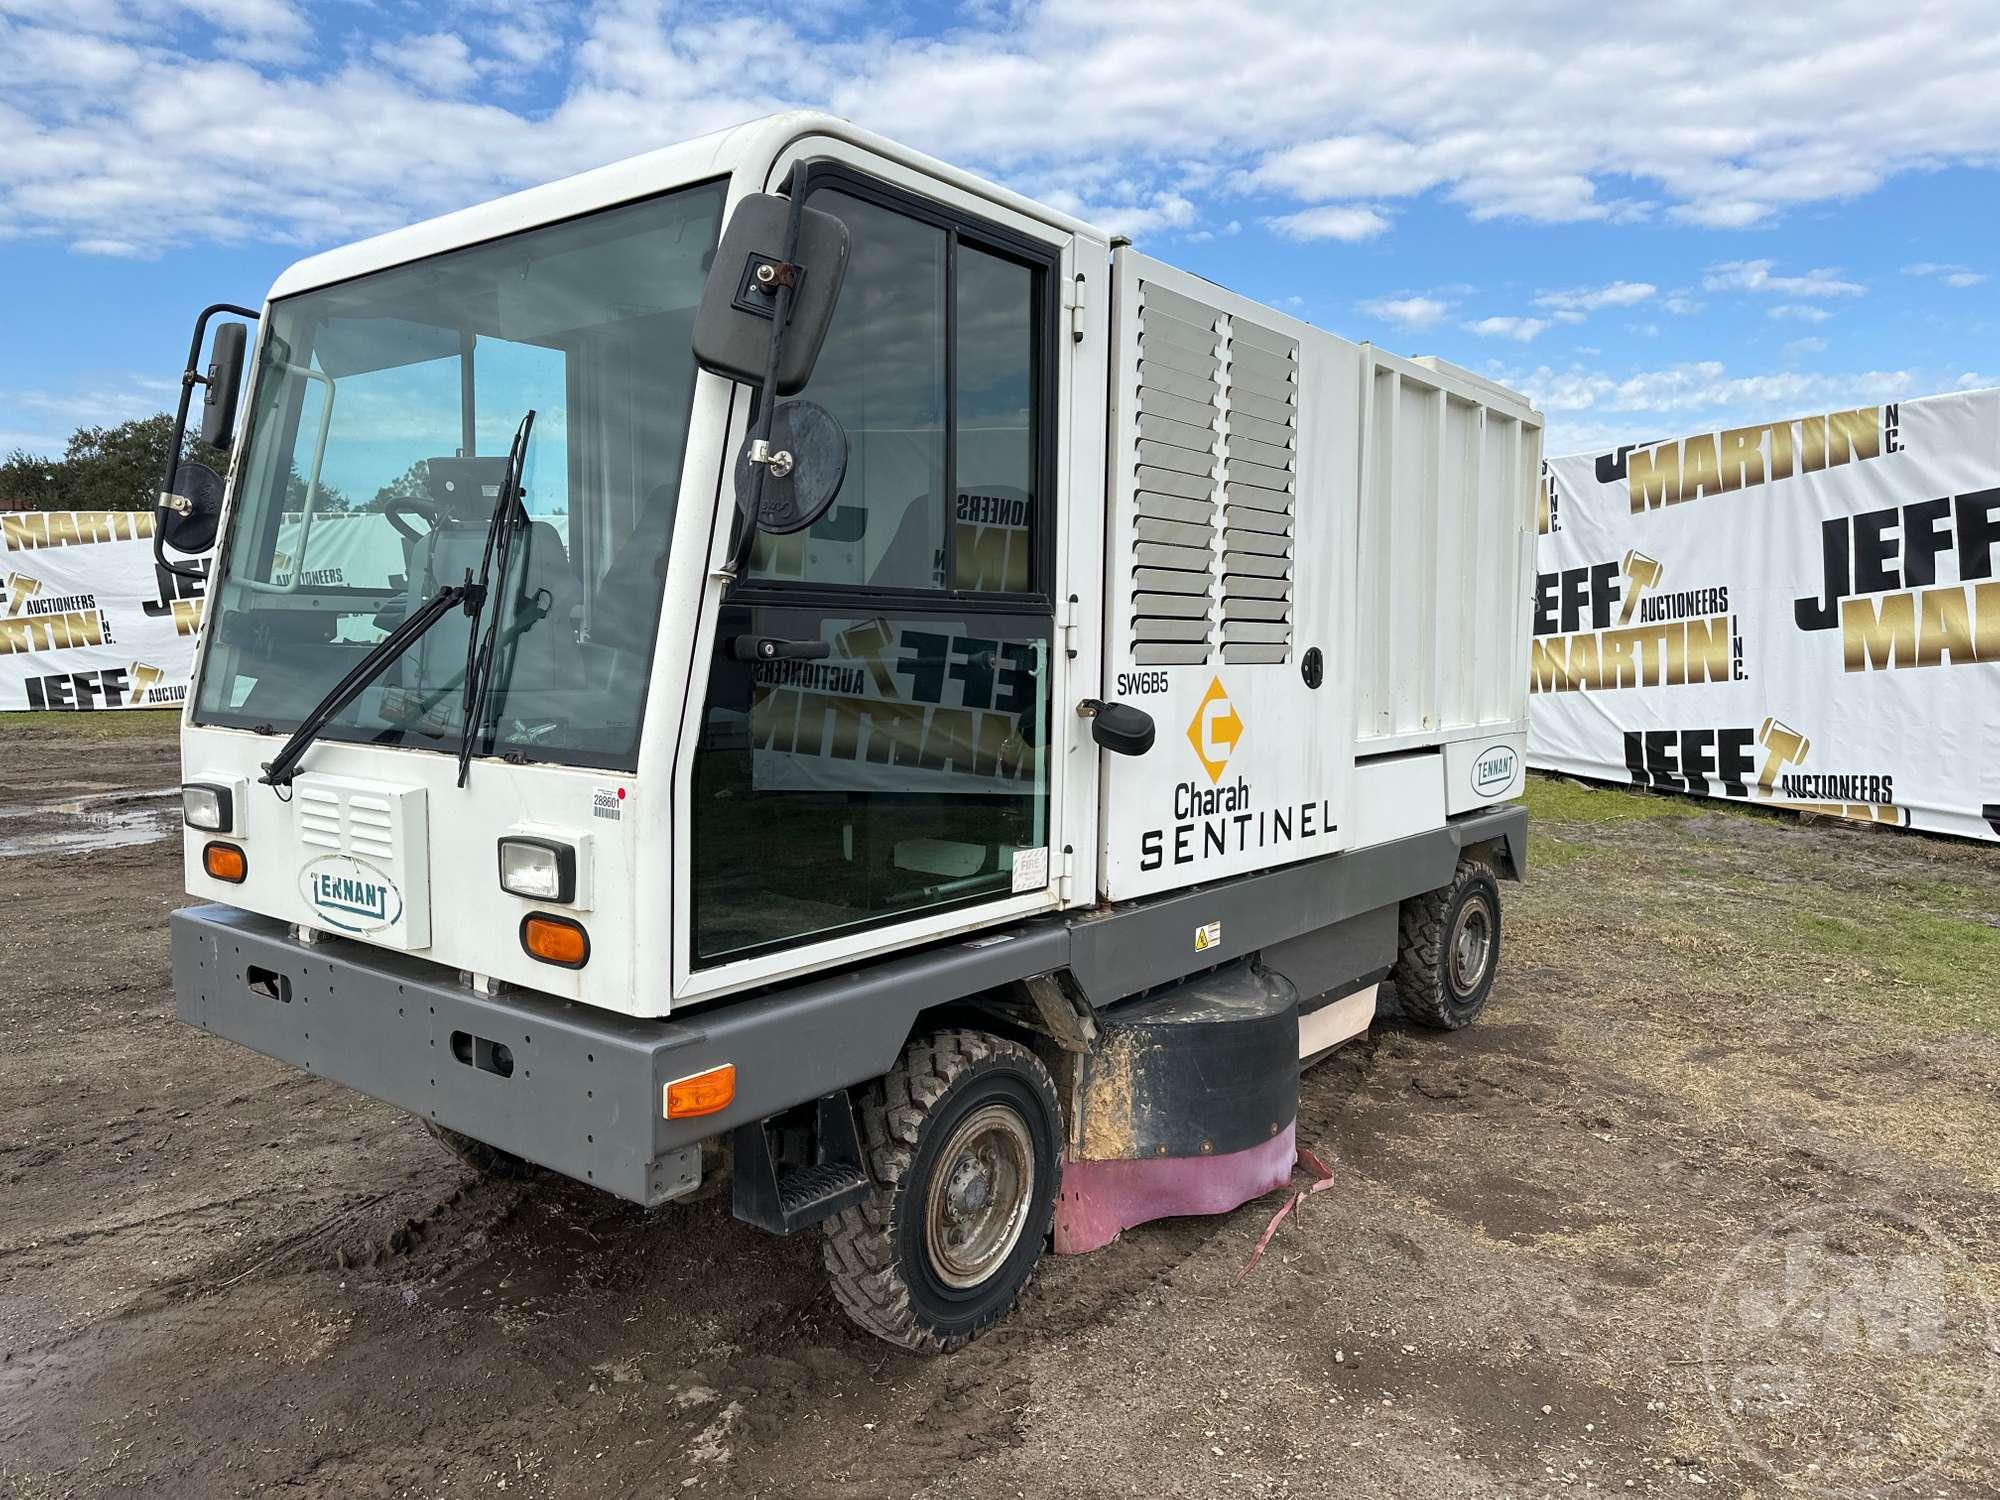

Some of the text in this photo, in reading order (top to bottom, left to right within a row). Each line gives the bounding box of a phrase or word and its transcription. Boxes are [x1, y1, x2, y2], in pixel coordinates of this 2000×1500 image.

[1629, 405, 1881, 514] MARTIN
[2, 511, 157, 552] MARTI
[1794, 487, 2000, 631] JEFF
[27, 594, 96, 615] AUCTIONEERS
[1640, 587, 1728, 623] AUCTIONEERS
[1530, 617, 1729, 694] MARTIN
[1732, 615, 1749, 680] INC.
[149, 685, 187, 703] AUCTIO
[1117, 671, 1168, 696] SW6B5
[1478, 756, 1513, 786] TENNANT
[1781, 775, 1893, 804] AUCTIONEERS
[1174, 775, 1249, 820] Charah
[1140, 800, 1338, 872] SENTINEL
